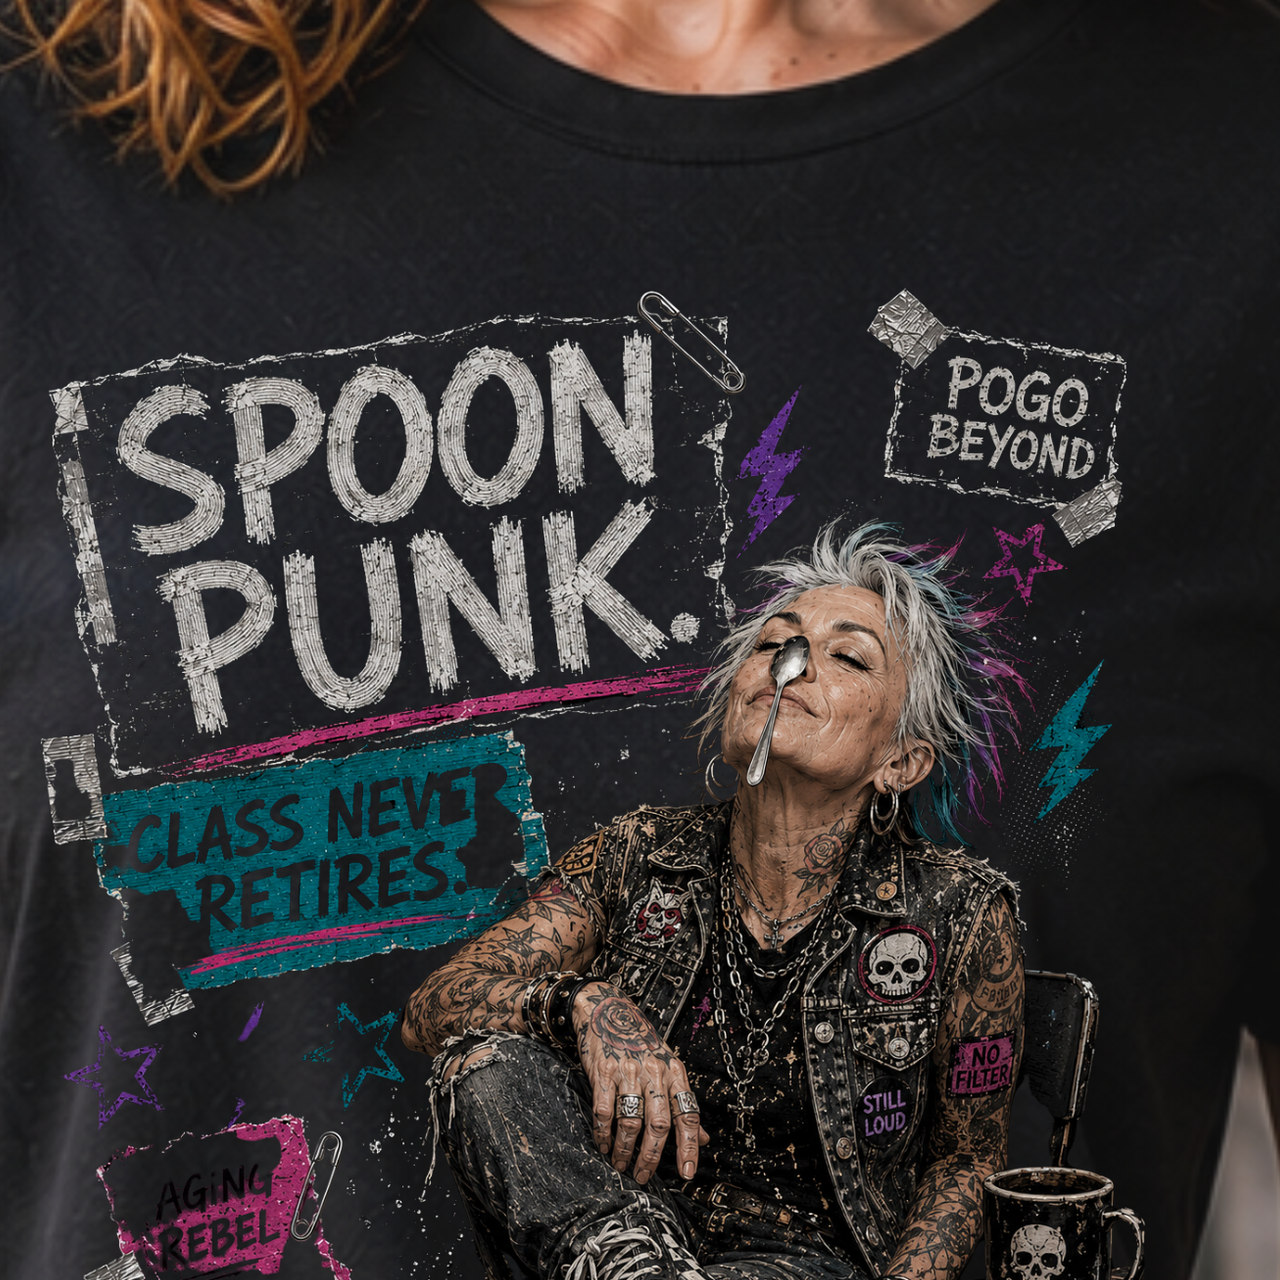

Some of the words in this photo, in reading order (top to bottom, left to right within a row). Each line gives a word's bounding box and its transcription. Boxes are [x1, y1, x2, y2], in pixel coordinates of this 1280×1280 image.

[947, 355, 1090, 428] POGO
[117, 328, 657, 555] SPOON
[926, 412, 1096, 480] BEYOND
[156, 496, 701, 734] PUNK.
[127, 793, 305, 874] CLASS
[195, 840, 469, 932] RETIRES.
[955, 1063, 1008, 1090] FILTER
[971, 1043, 1001, 1068] NO
[862, 1089, 907, 1115] STILL
[864, 1111, 907, 1137] LOUD
[157, 1209, 282, 1272] REBEL
